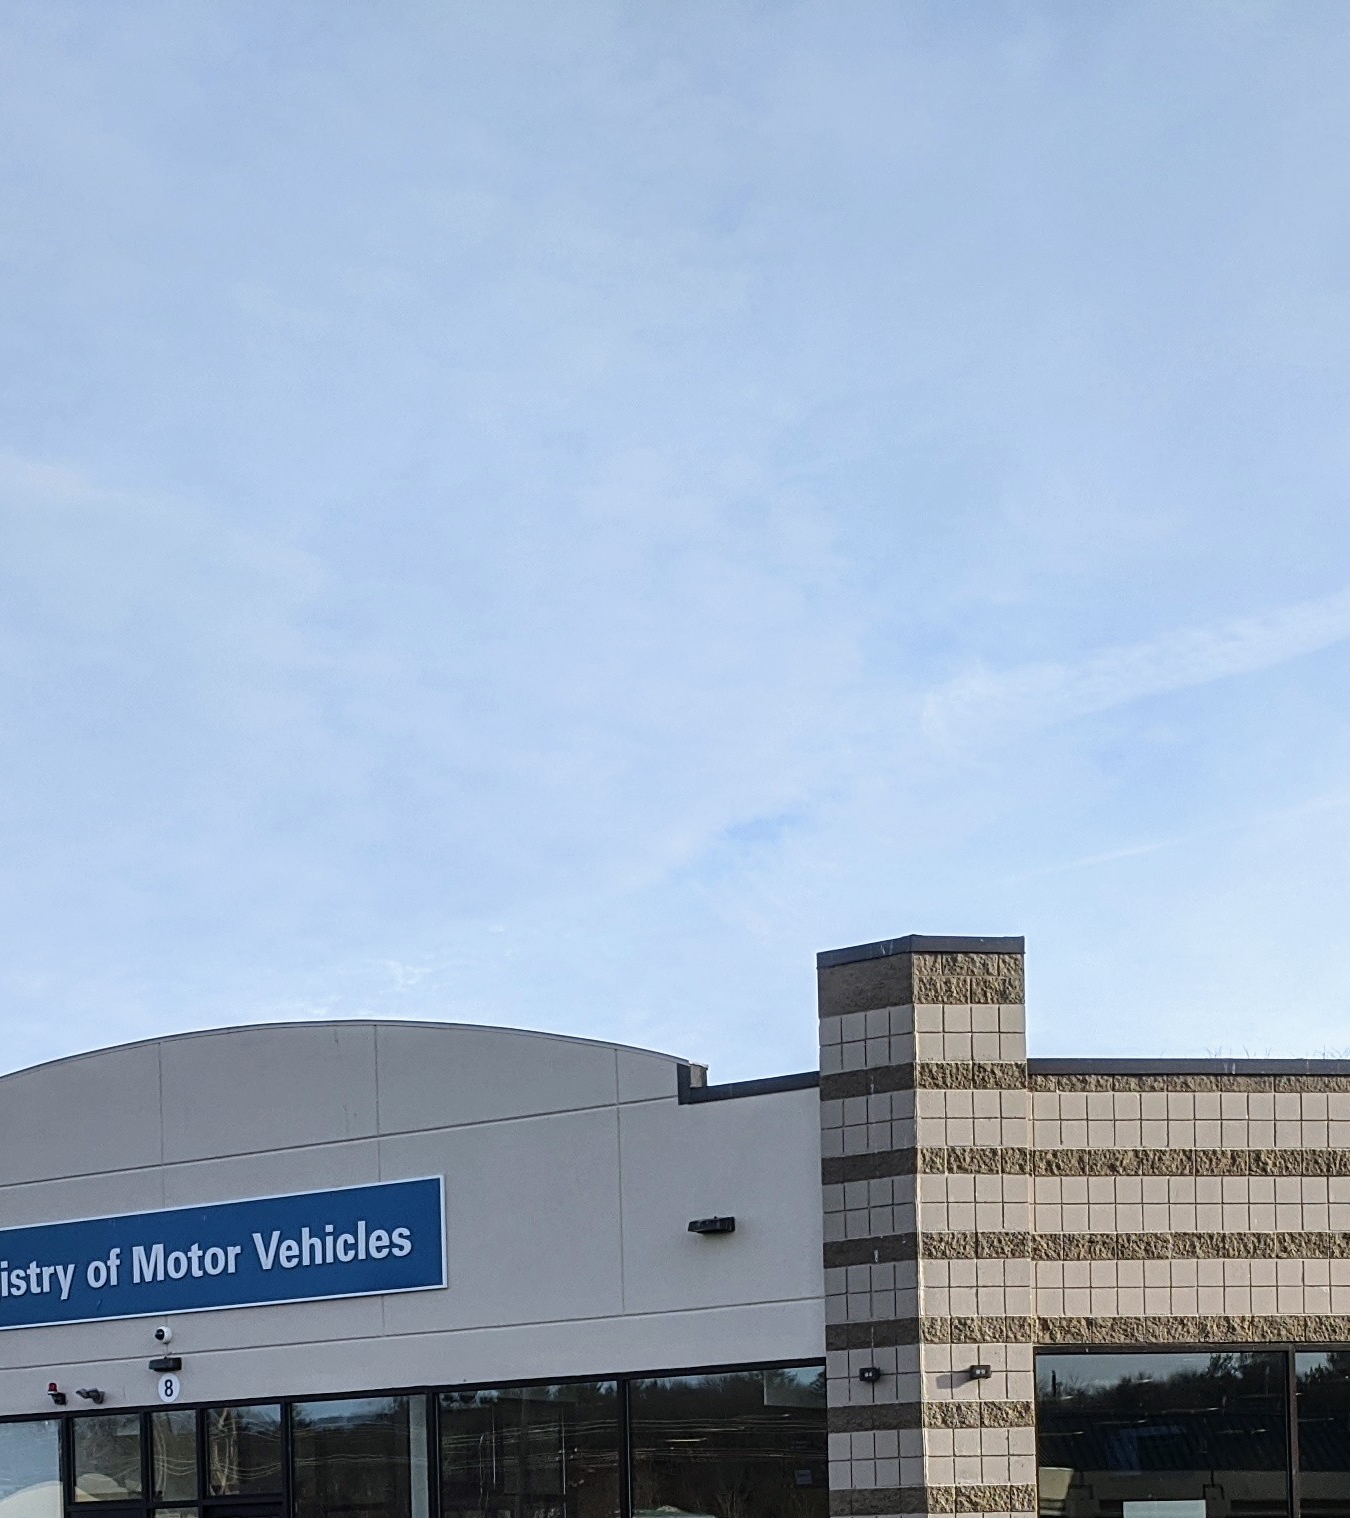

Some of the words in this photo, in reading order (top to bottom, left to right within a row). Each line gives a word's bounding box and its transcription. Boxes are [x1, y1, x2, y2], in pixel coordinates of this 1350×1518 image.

[87, 1248, 121, 1288] of
[132, 1243, 241, 1284] Motor
[252, 1220, 412, 1270] Vehicles
[164, 1378, 174, 1397] 8
